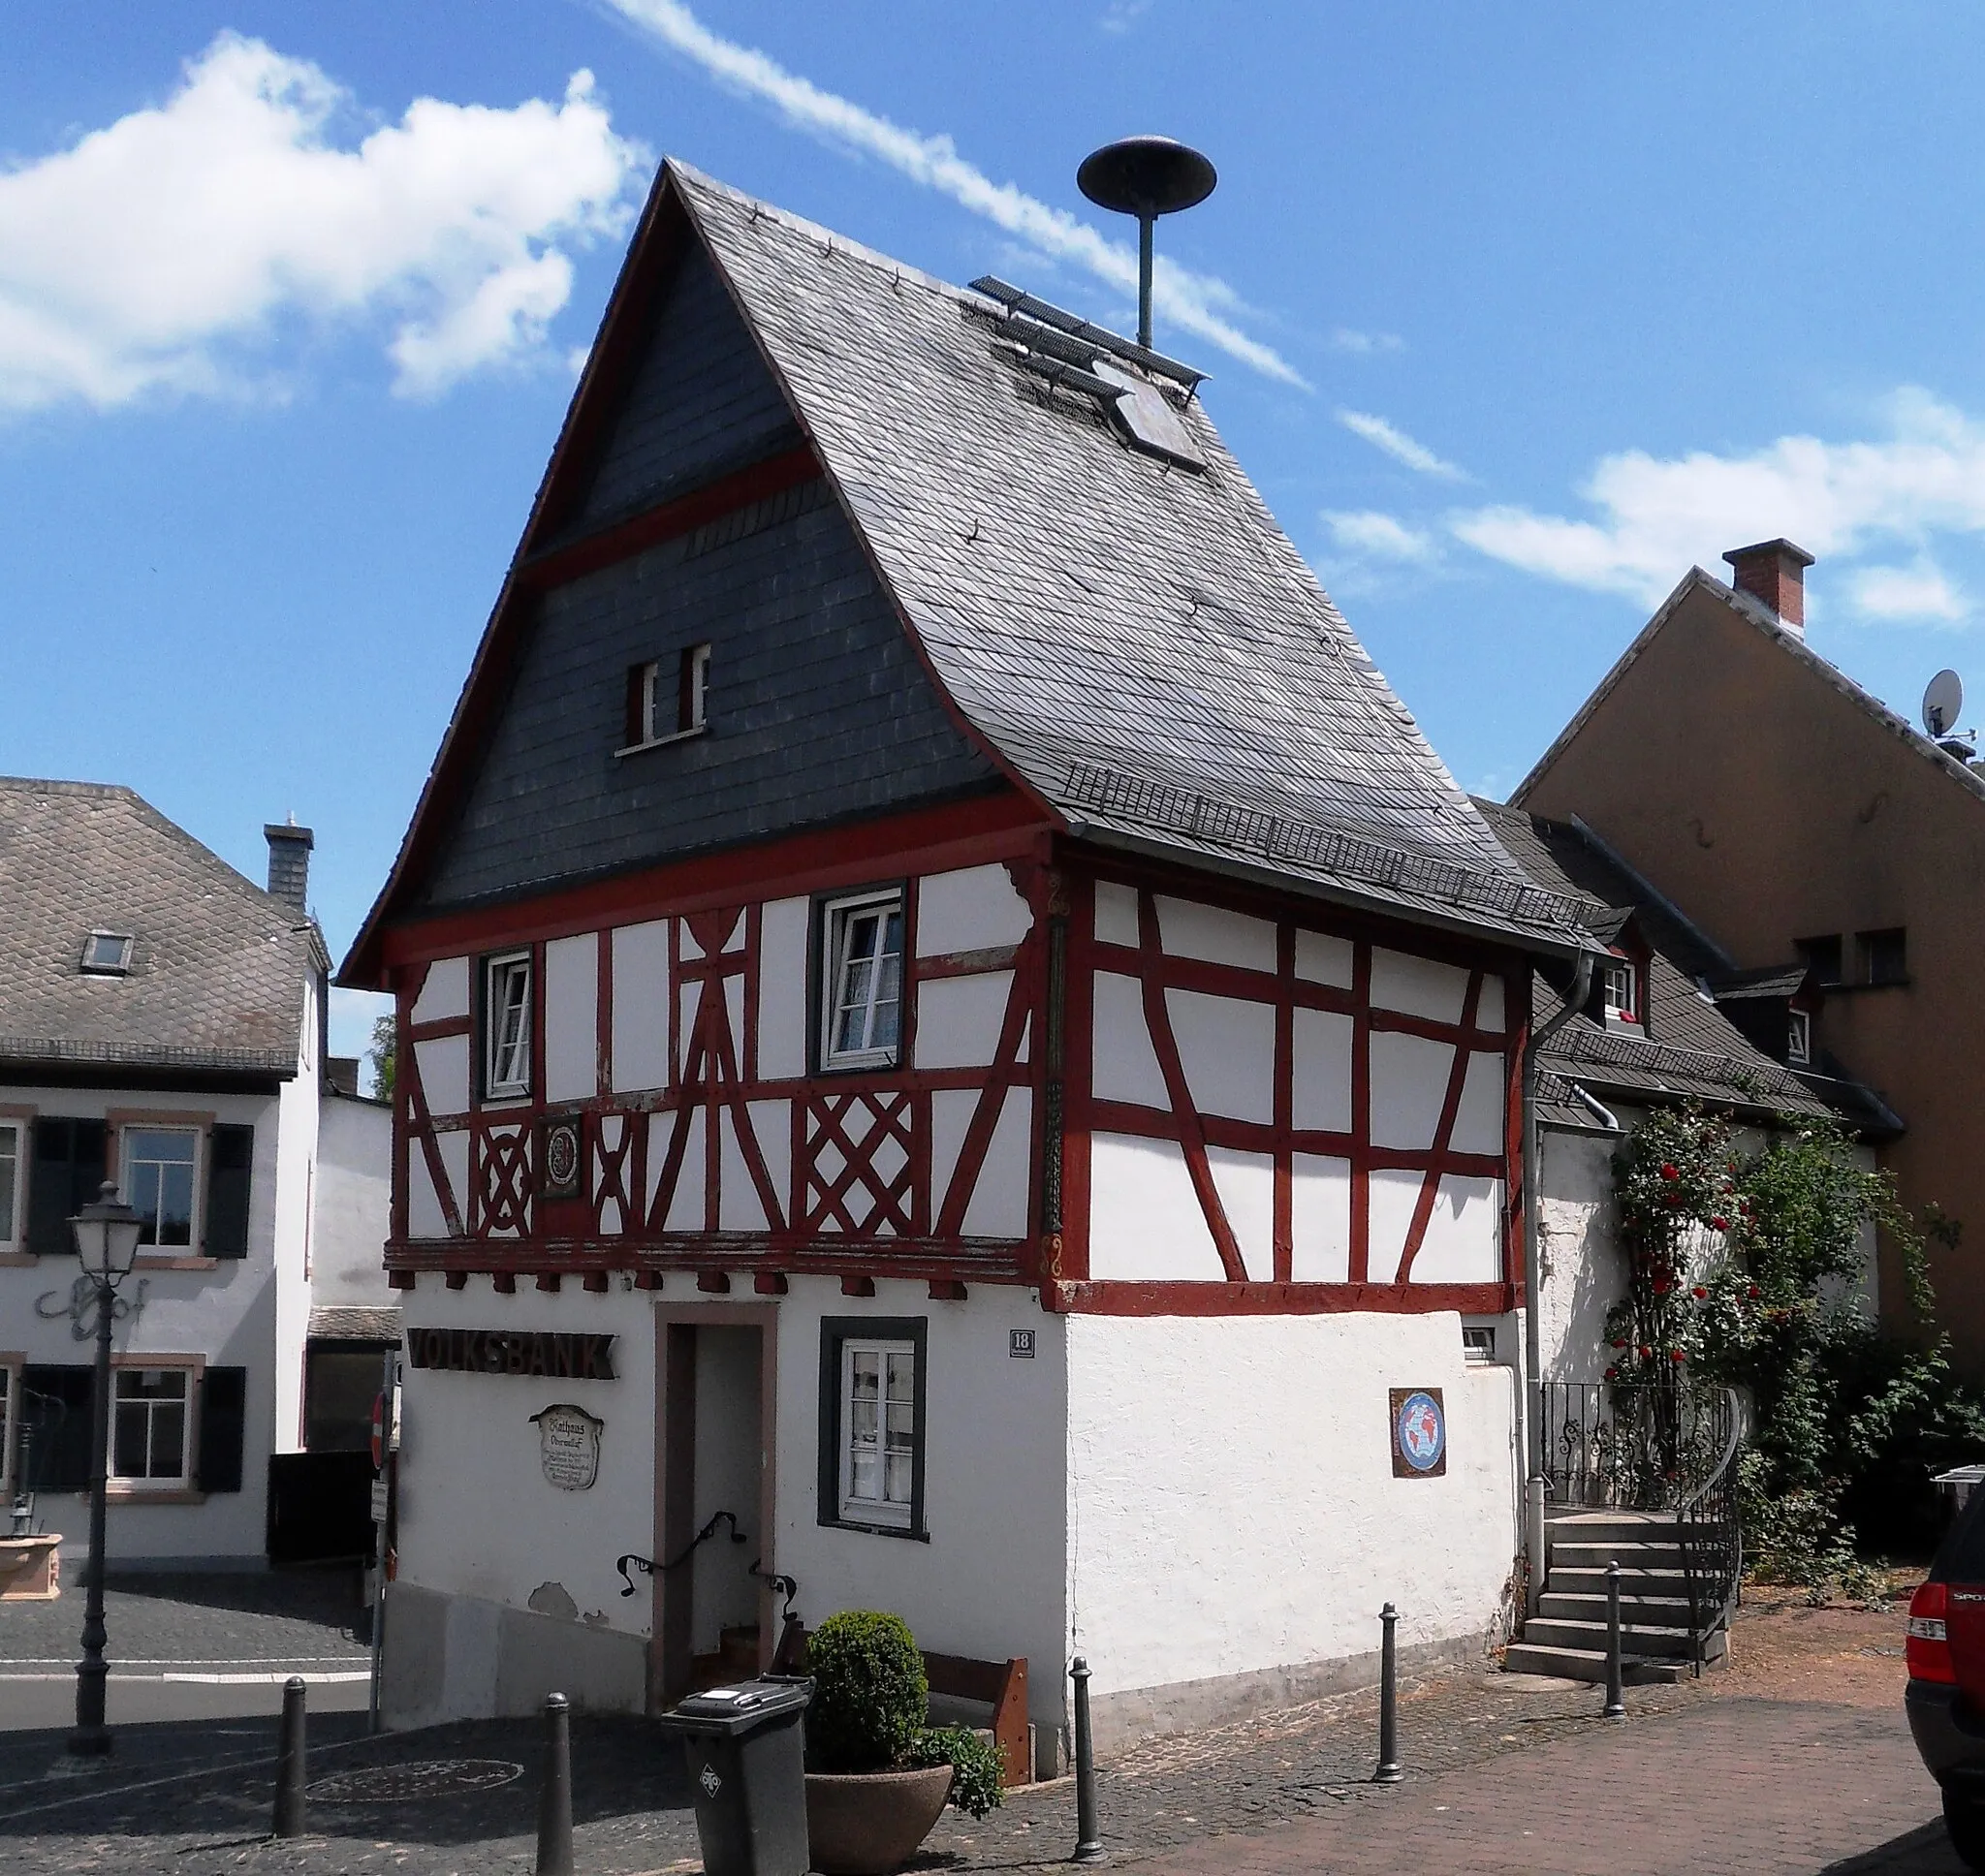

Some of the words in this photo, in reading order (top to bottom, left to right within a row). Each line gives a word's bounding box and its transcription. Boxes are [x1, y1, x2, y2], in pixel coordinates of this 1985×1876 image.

[1015, 1333, 1029, 1349] 18
[407, 1328, 614, 1379] VOLKSBANK
[548, 1418, 584, 1437] Rathaus
